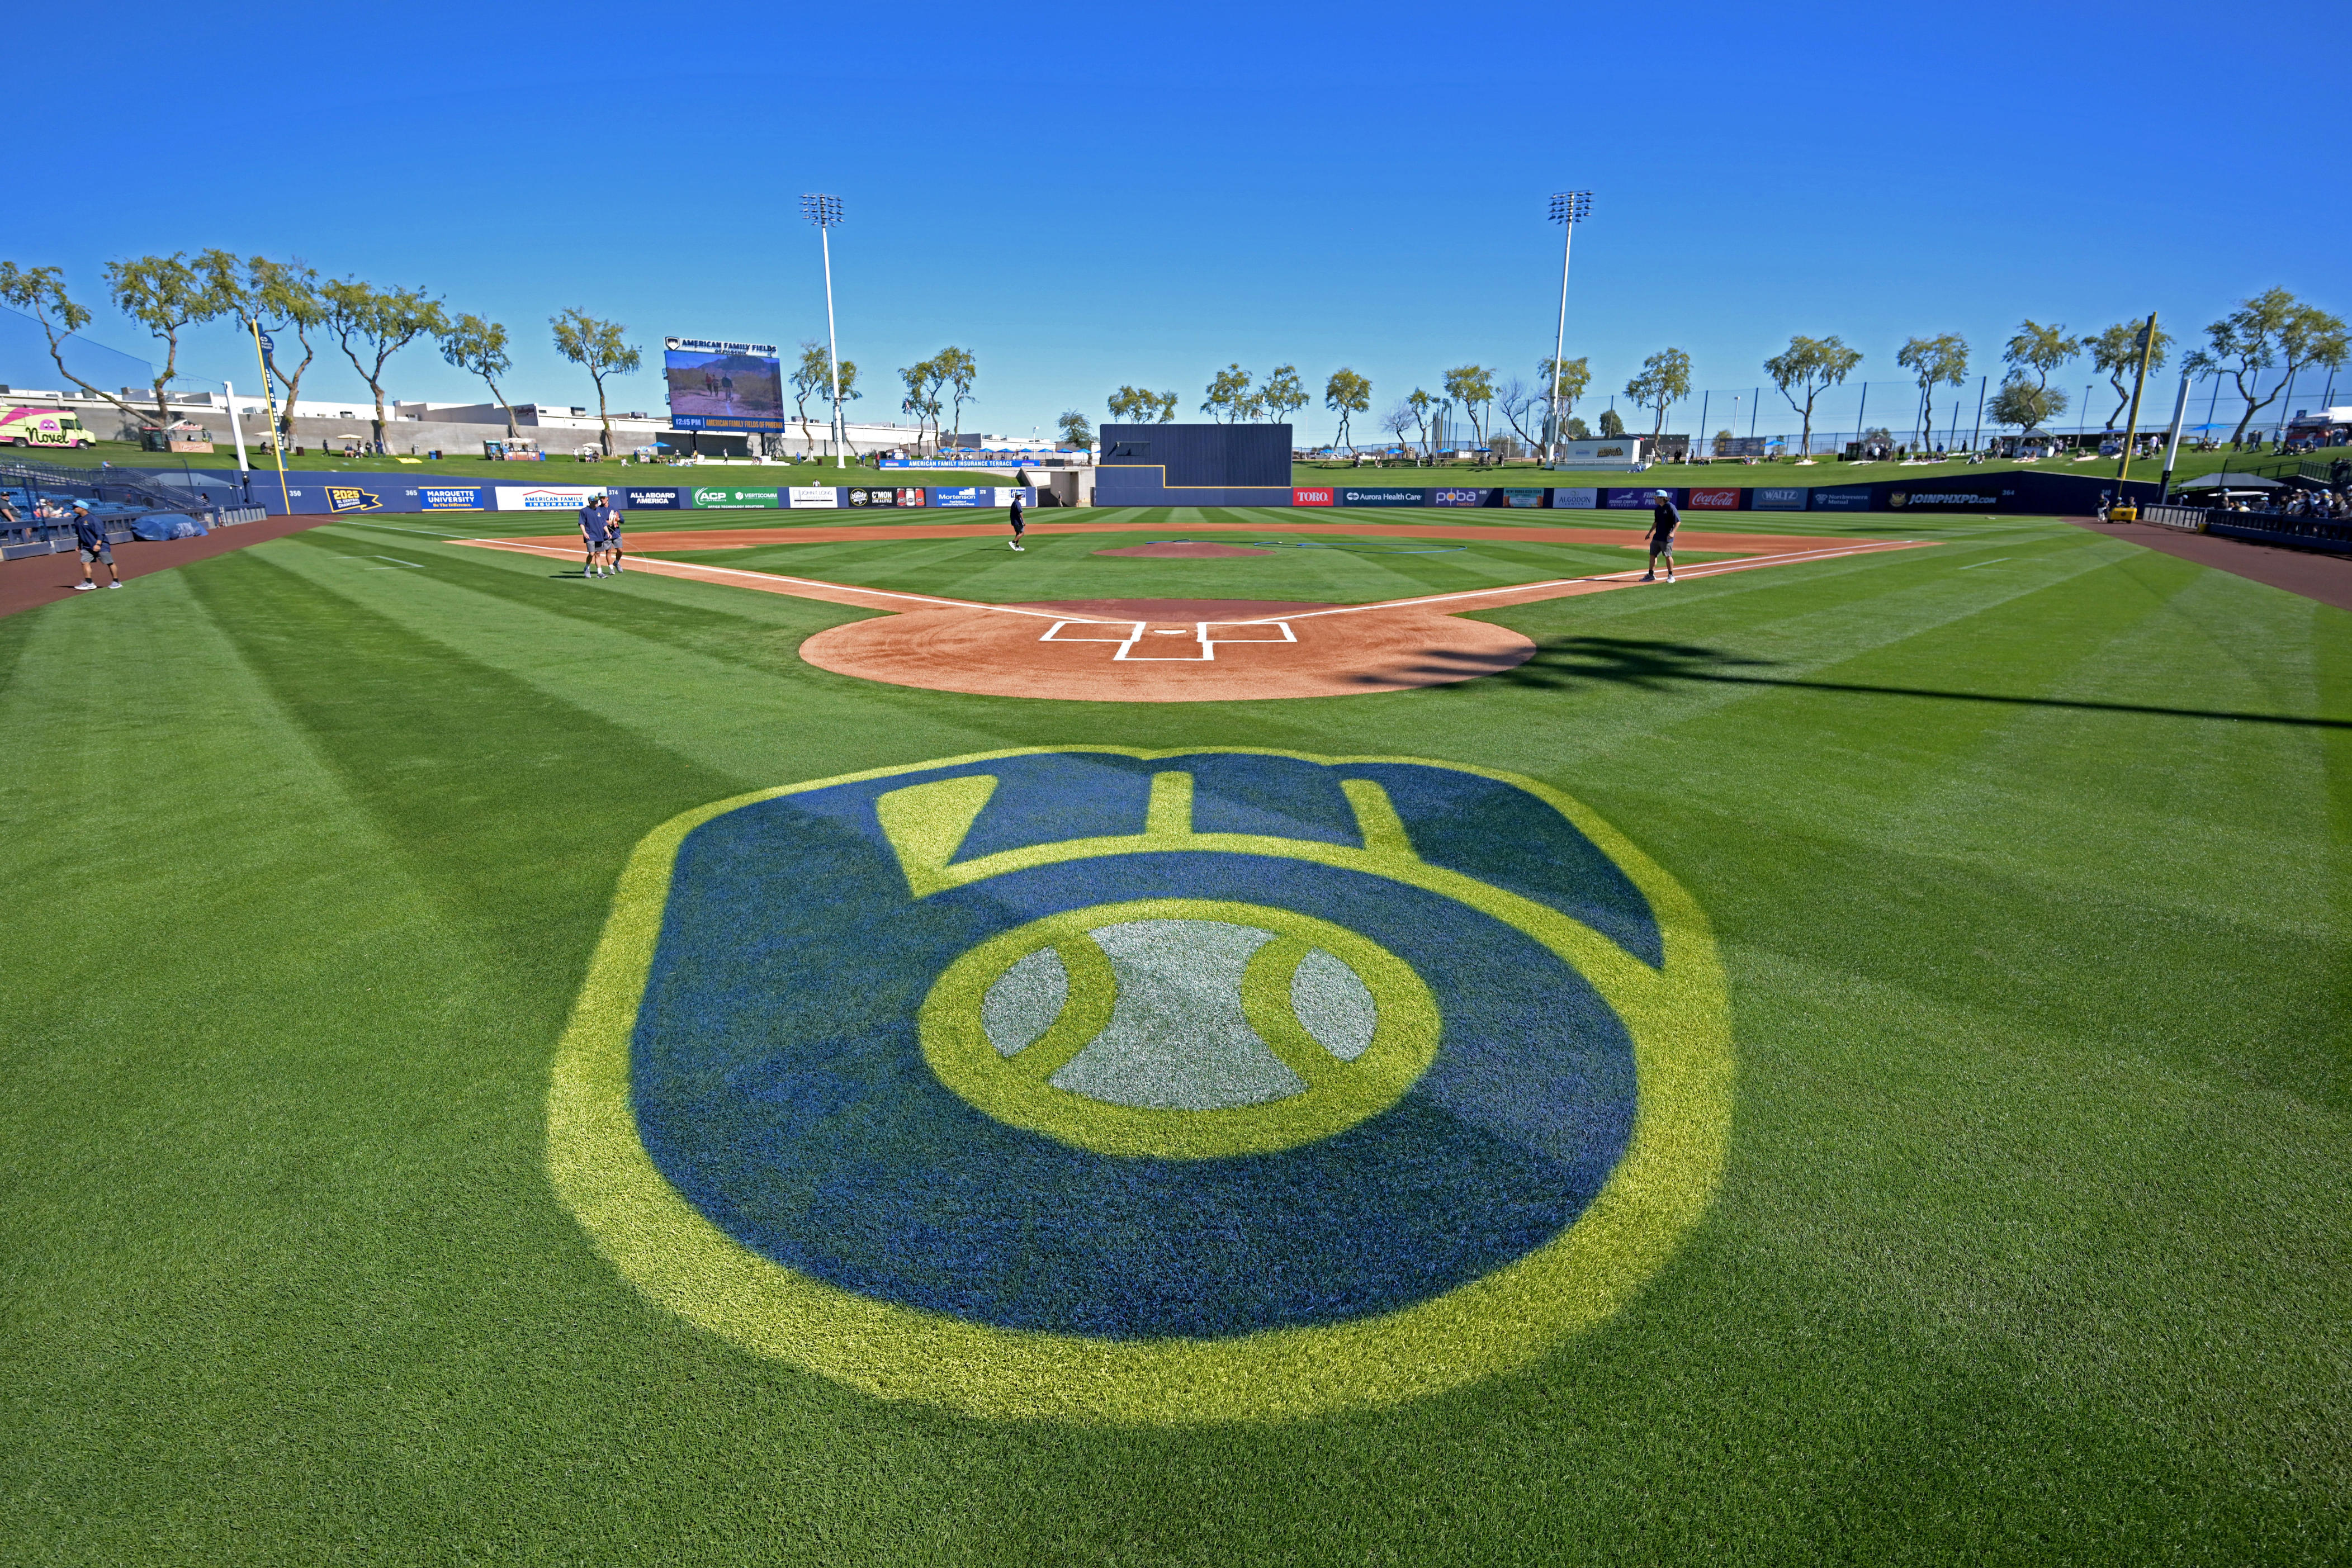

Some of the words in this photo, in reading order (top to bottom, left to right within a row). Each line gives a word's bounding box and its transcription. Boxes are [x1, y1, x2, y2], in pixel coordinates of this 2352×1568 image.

[682, 339, 722, 348] AMERICAN
[269, 393, 275, 402] GO
[25, 427, 69, 444] Novel
[333, 490, 360, 500] 2025
[1298, 492, 1328, 501] TORO
[1436, 489, 1476, 505] poba
[1692, 492, 1735, 505] Coca-Cola
[1764, 490, 1796, 500] WALTZ
[1909, 494, 1996, 505] JOINPHXPD.COM
